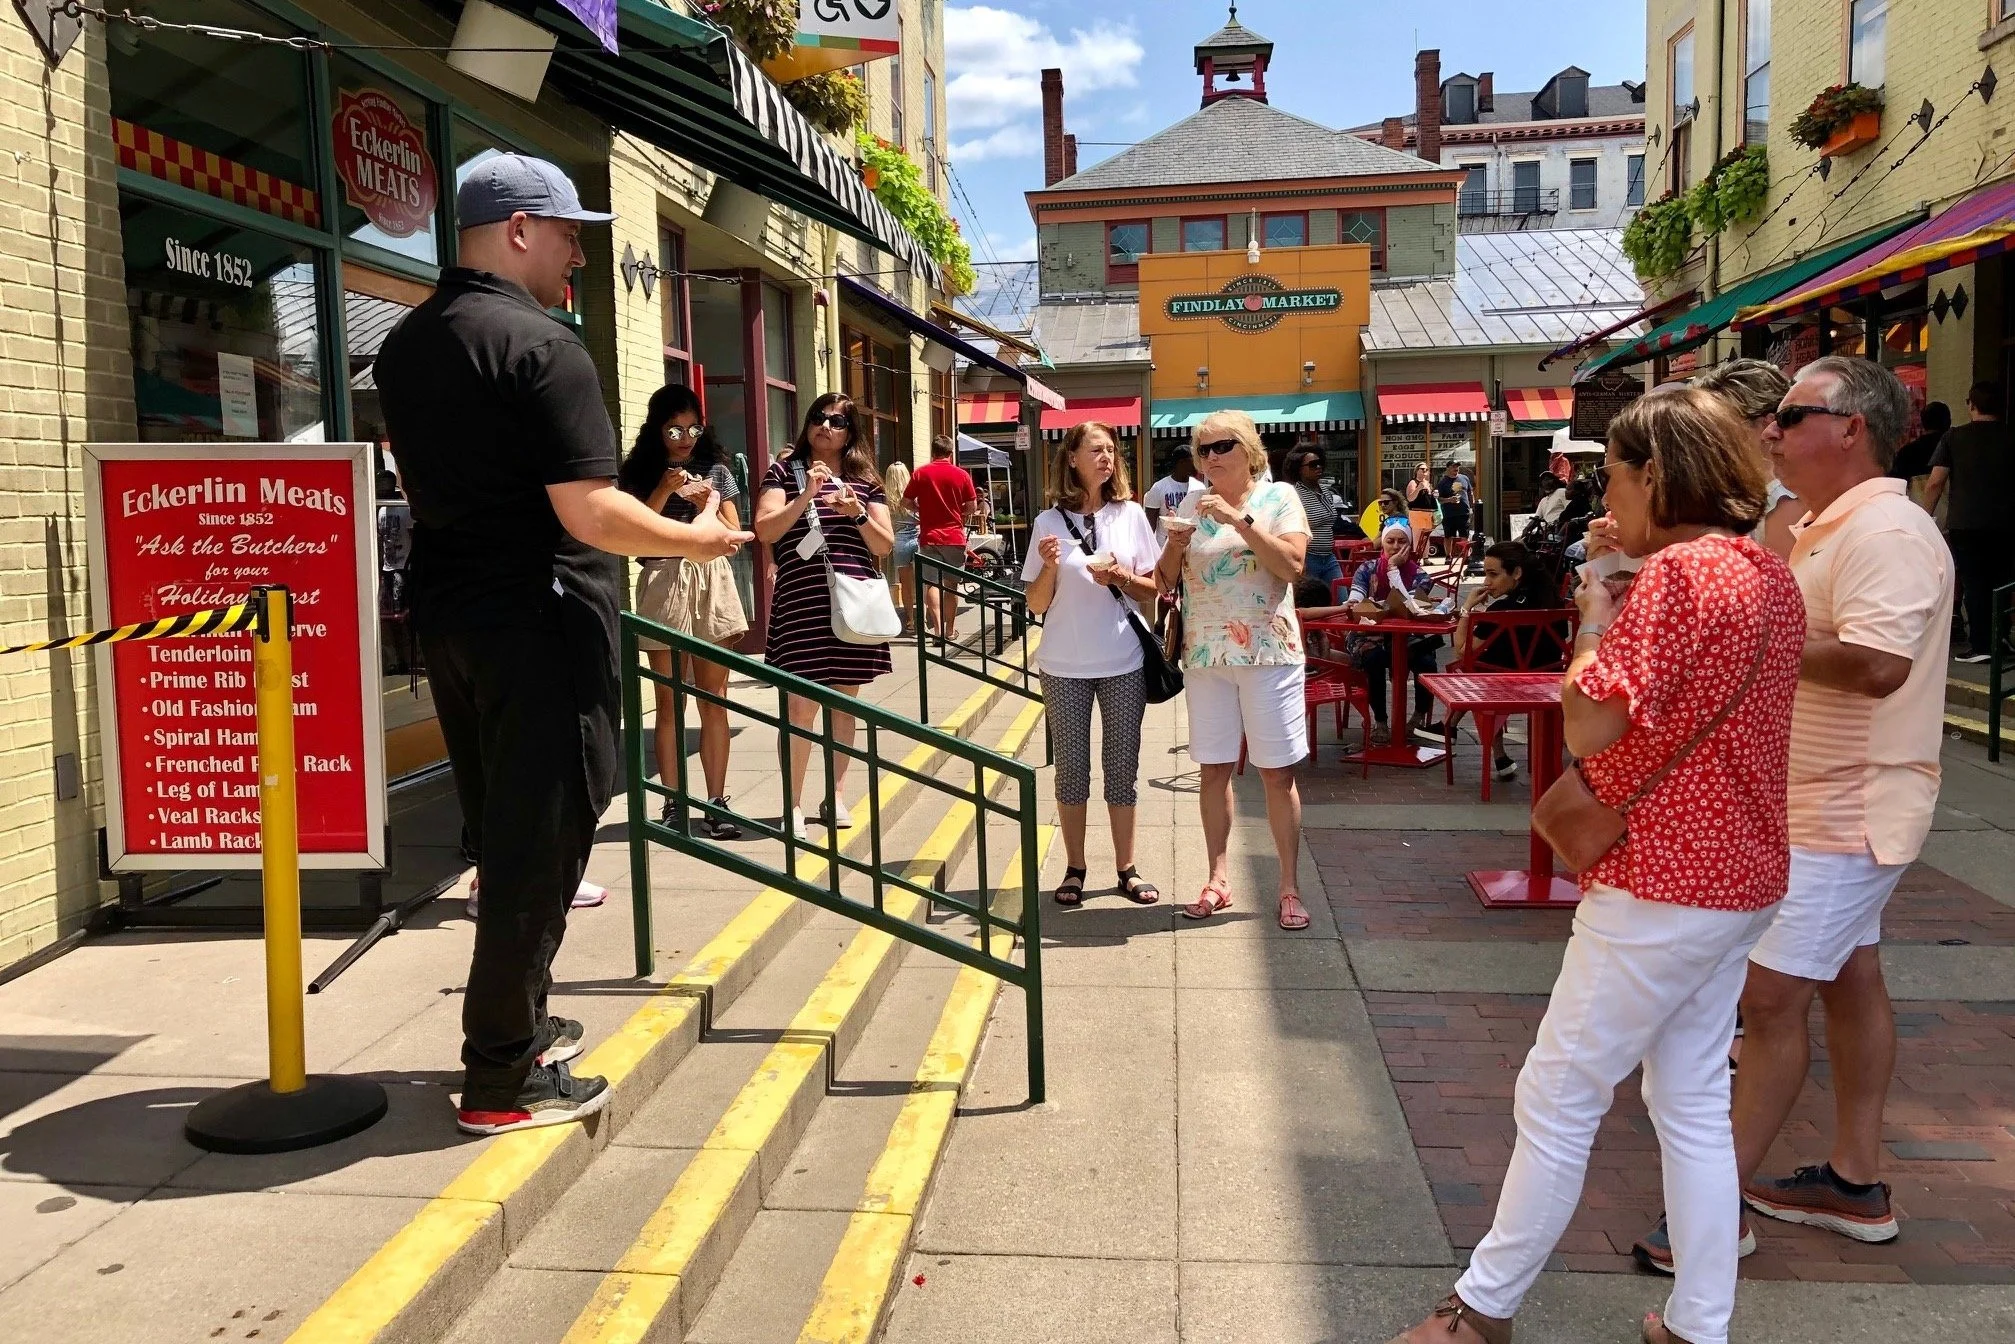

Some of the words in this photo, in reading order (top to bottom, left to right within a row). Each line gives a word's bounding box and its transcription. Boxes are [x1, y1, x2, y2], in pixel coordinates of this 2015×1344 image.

[350, 116, 421, 176] Eckerlin
[356, 154, 420, 208] MEATS
[165, 237, 210, 278] Since
[213, 251, 253, 289] 1852
[1228, 278, 1253, 292] SINCE
[1171, 299, 1246, 314] FINDLAY
[1262, 293, 1338, 309] MARKET
[1228, 314, 1278, 329] CINCINNATI
[1383, 452, 1426, 460] PRODUCE
[122, 477, 246, 518] Eckerlin
[259, 477, 347, 516] Meats
[199, 513, 235, 526] Since
[239, 513, 274, 526] 1852
[135, 534, 185, 557] "Ask
[191, 535, 224, 556] the
[230, 533, 339, 556] Butchers"
[204, 562, 229, 581] for
[233, 565, 270, 580] your
[157, 584, 250, 606] Holiday
[147, 645, 252, 663] Tenderloin
[150, 671, 208, 689] Prime
[214, 671, 246, 689] Rib
[152, 699, 184, 718] Old
[153, 728, 210, 749] Spiral
[155, 755, 244, 773] Frenched
[303, 754, 352, 773] Rack
[157, 781, 192, 802] Leg
[197, 780, 216, 798] of
[157, 807, 199, 825] Veal
[205, 807, 262, 825] Racks
[160, 832, 213, 849] Lamb
